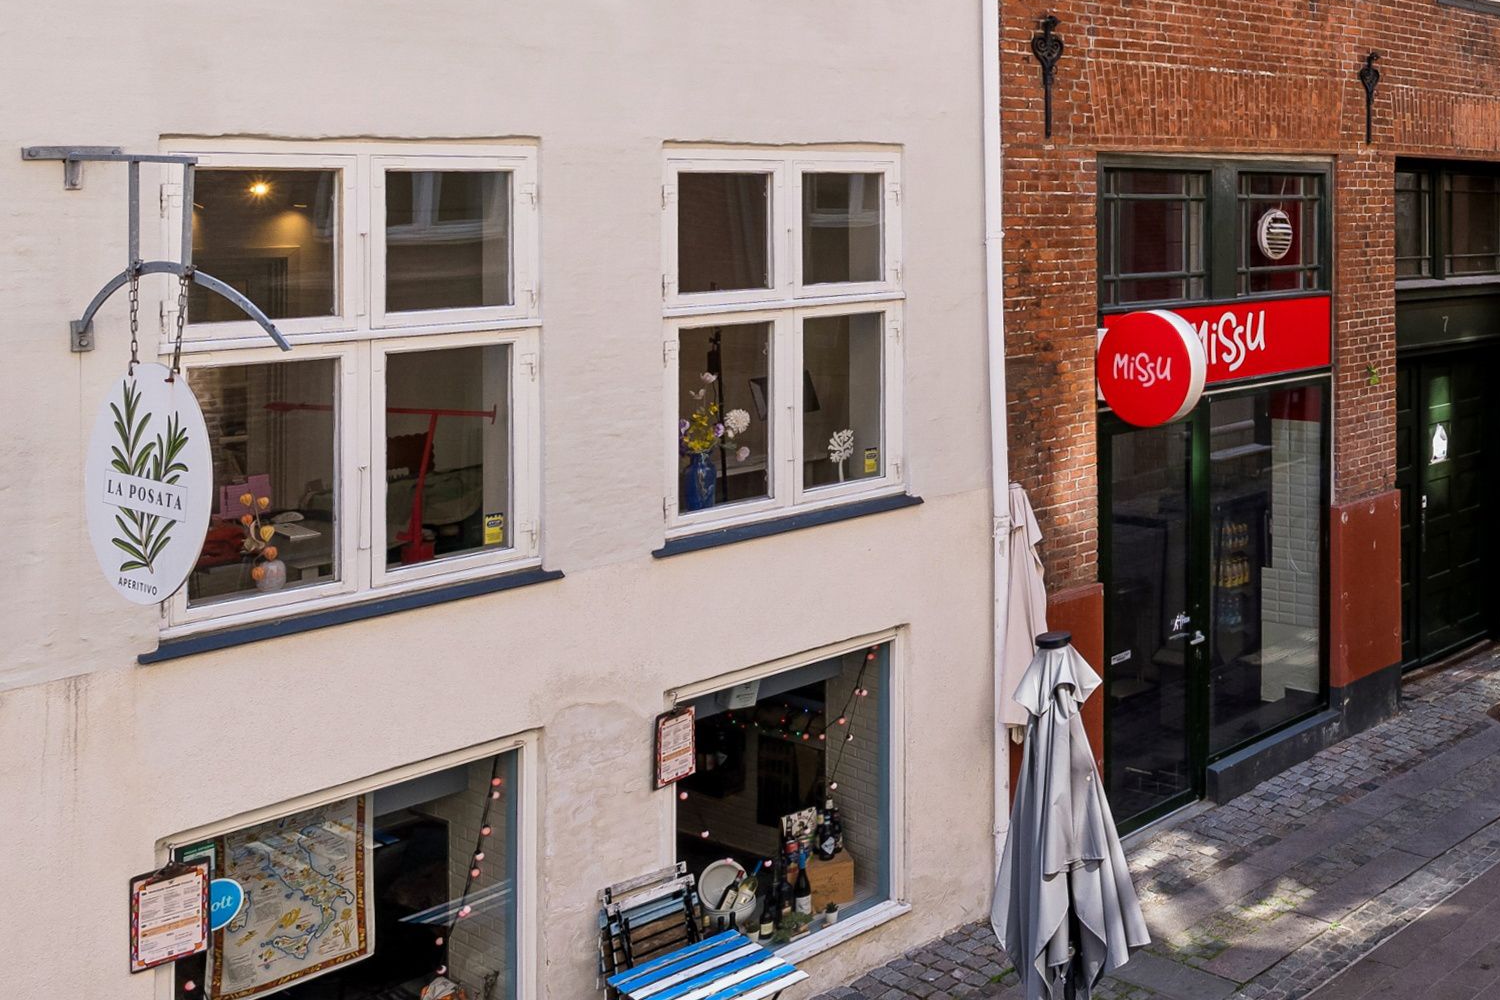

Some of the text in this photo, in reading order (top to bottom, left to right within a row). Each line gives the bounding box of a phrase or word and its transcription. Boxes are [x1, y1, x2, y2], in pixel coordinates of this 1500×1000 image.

[1442, 316, 1449, 333] 7
[107, 479, 182, 511] LA POSATA
[118, 577, 158, 596] APERITIVO
[211, 895, 233, 912] olt
